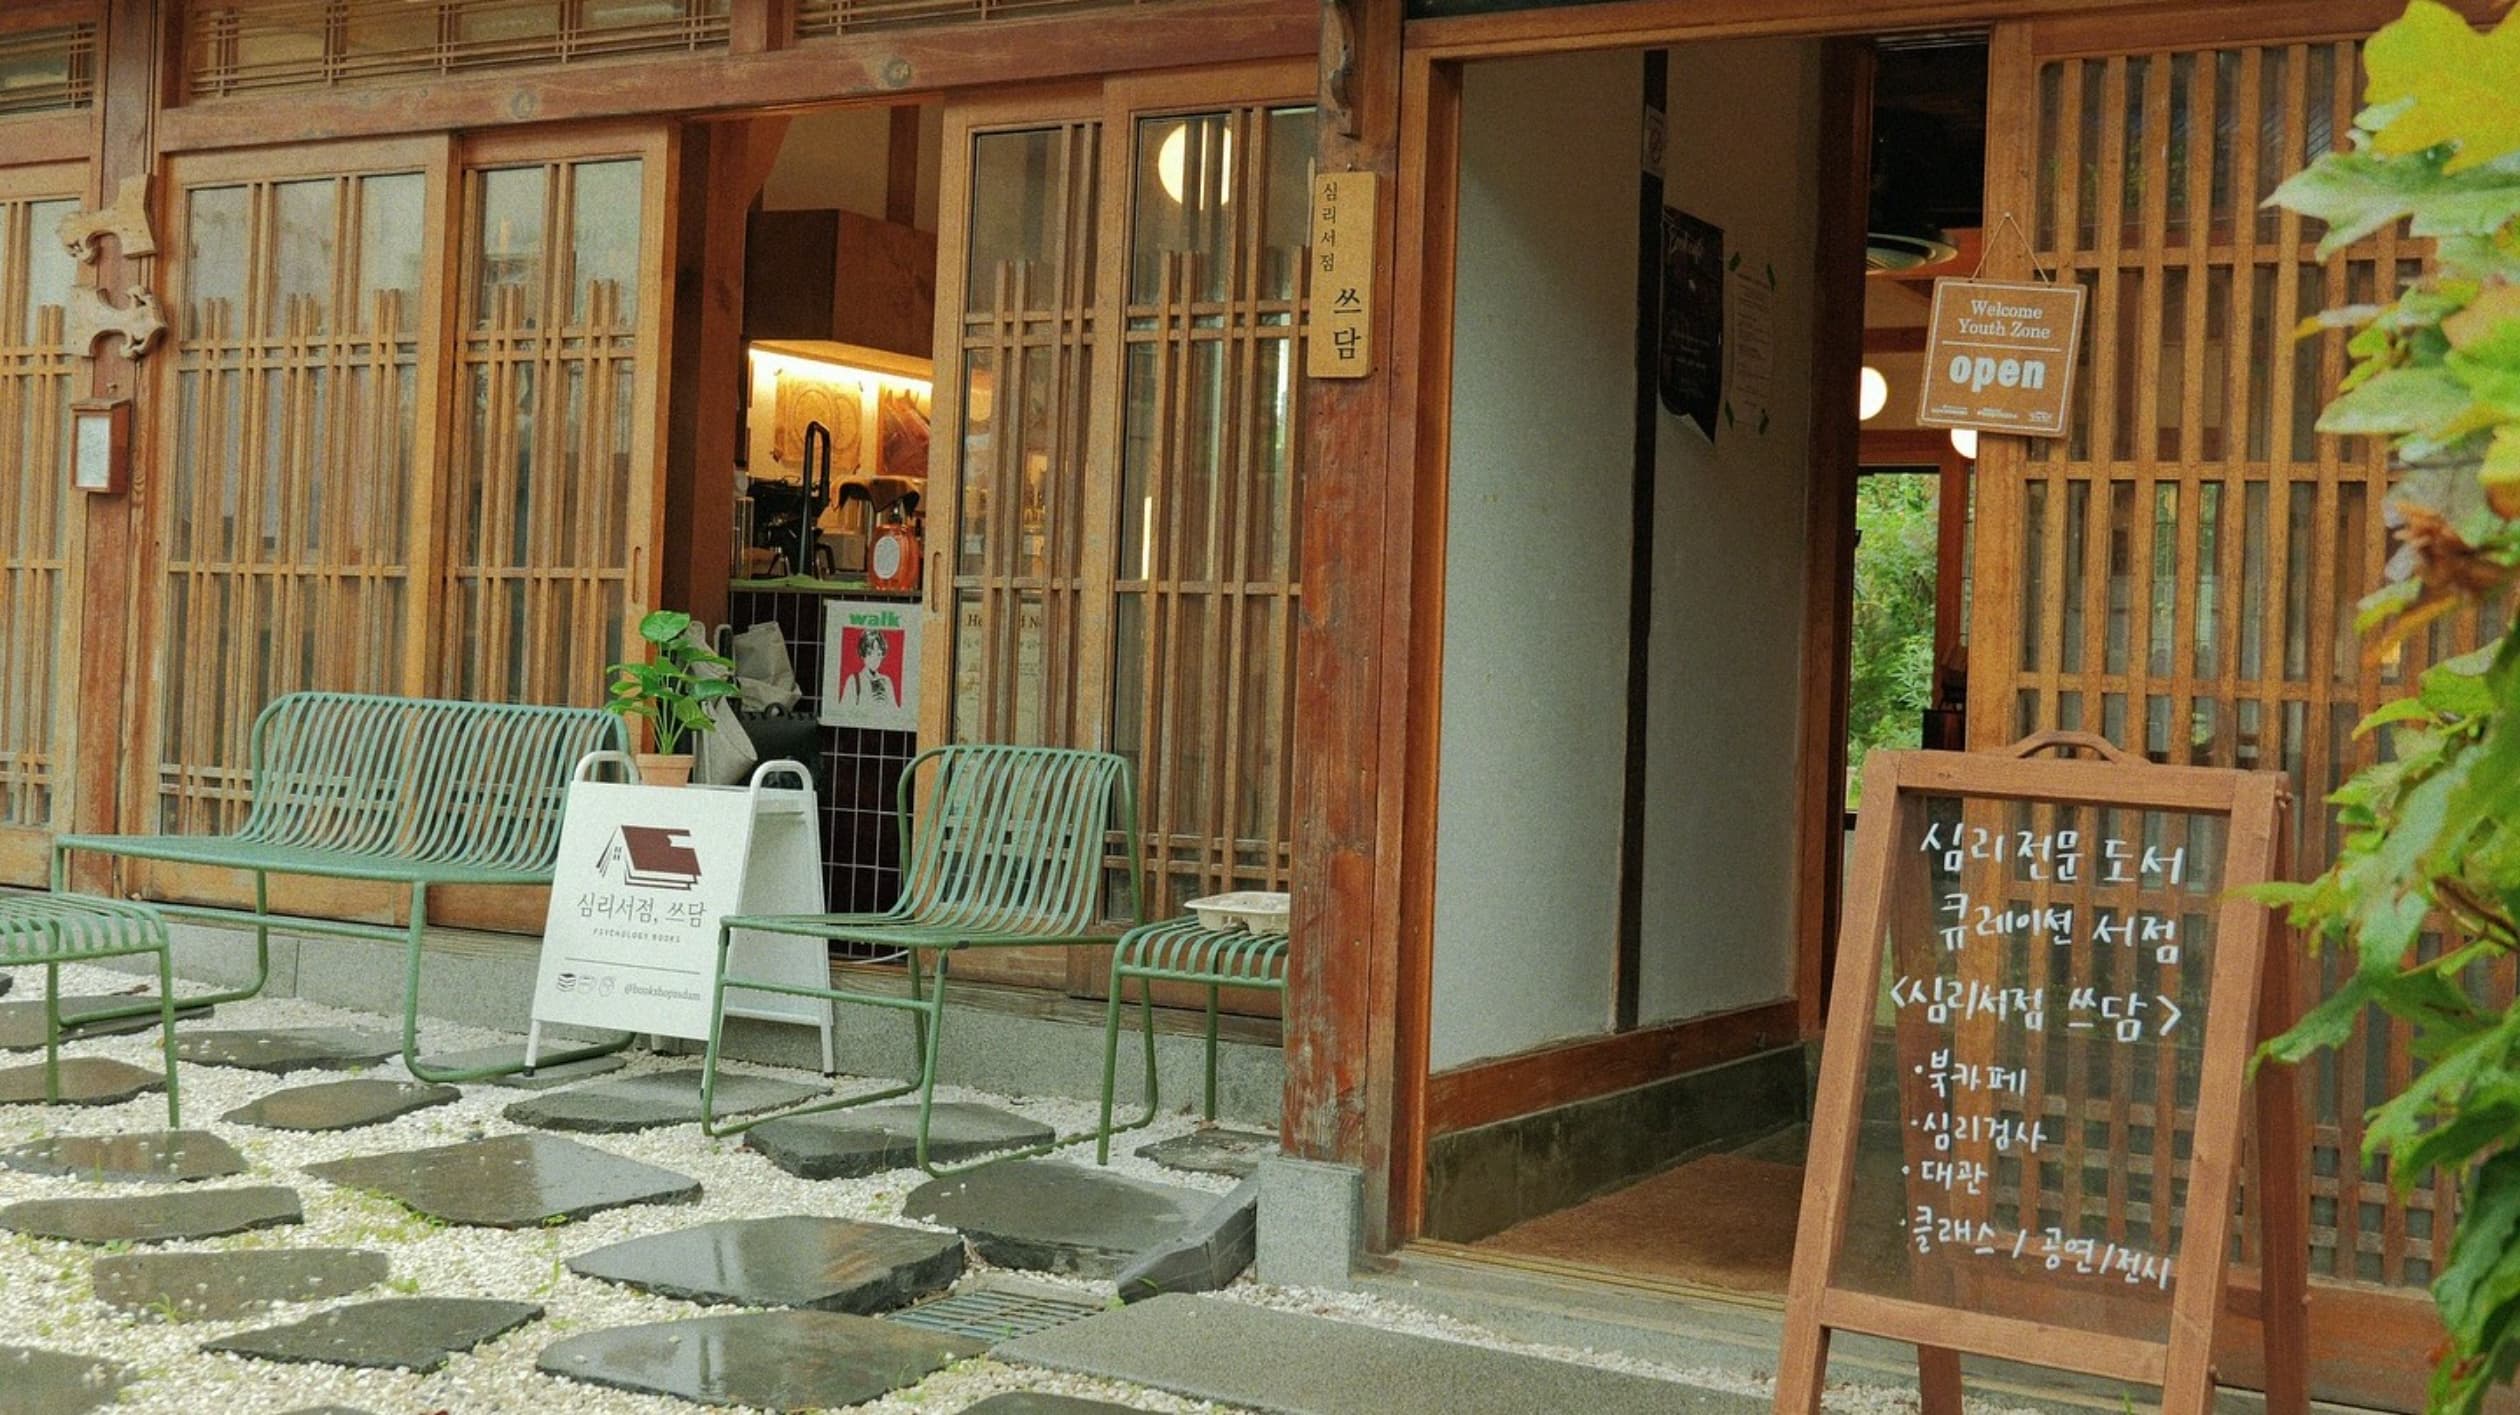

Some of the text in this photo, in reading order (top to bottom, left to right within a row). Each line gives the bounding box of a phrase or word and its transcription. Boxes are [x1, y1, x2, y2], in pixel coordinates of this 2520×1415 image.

[1319, 181, 1337, 272] 심리서점
[1333, 288, 1362, 360] 쓰담
[1958, 318, 2051, 340] Youth Zone
[1971, 299, 2043, 320] Welcome
[1949, 355, 2046, 394] open
[849, 611, 901, 628] walk
[2103, 839, 2185, 885] 도서
[577, 892, 707, 928] 심리서점, 쓰담
[1939, 893, 2181, 965] 큐레이션 서점
